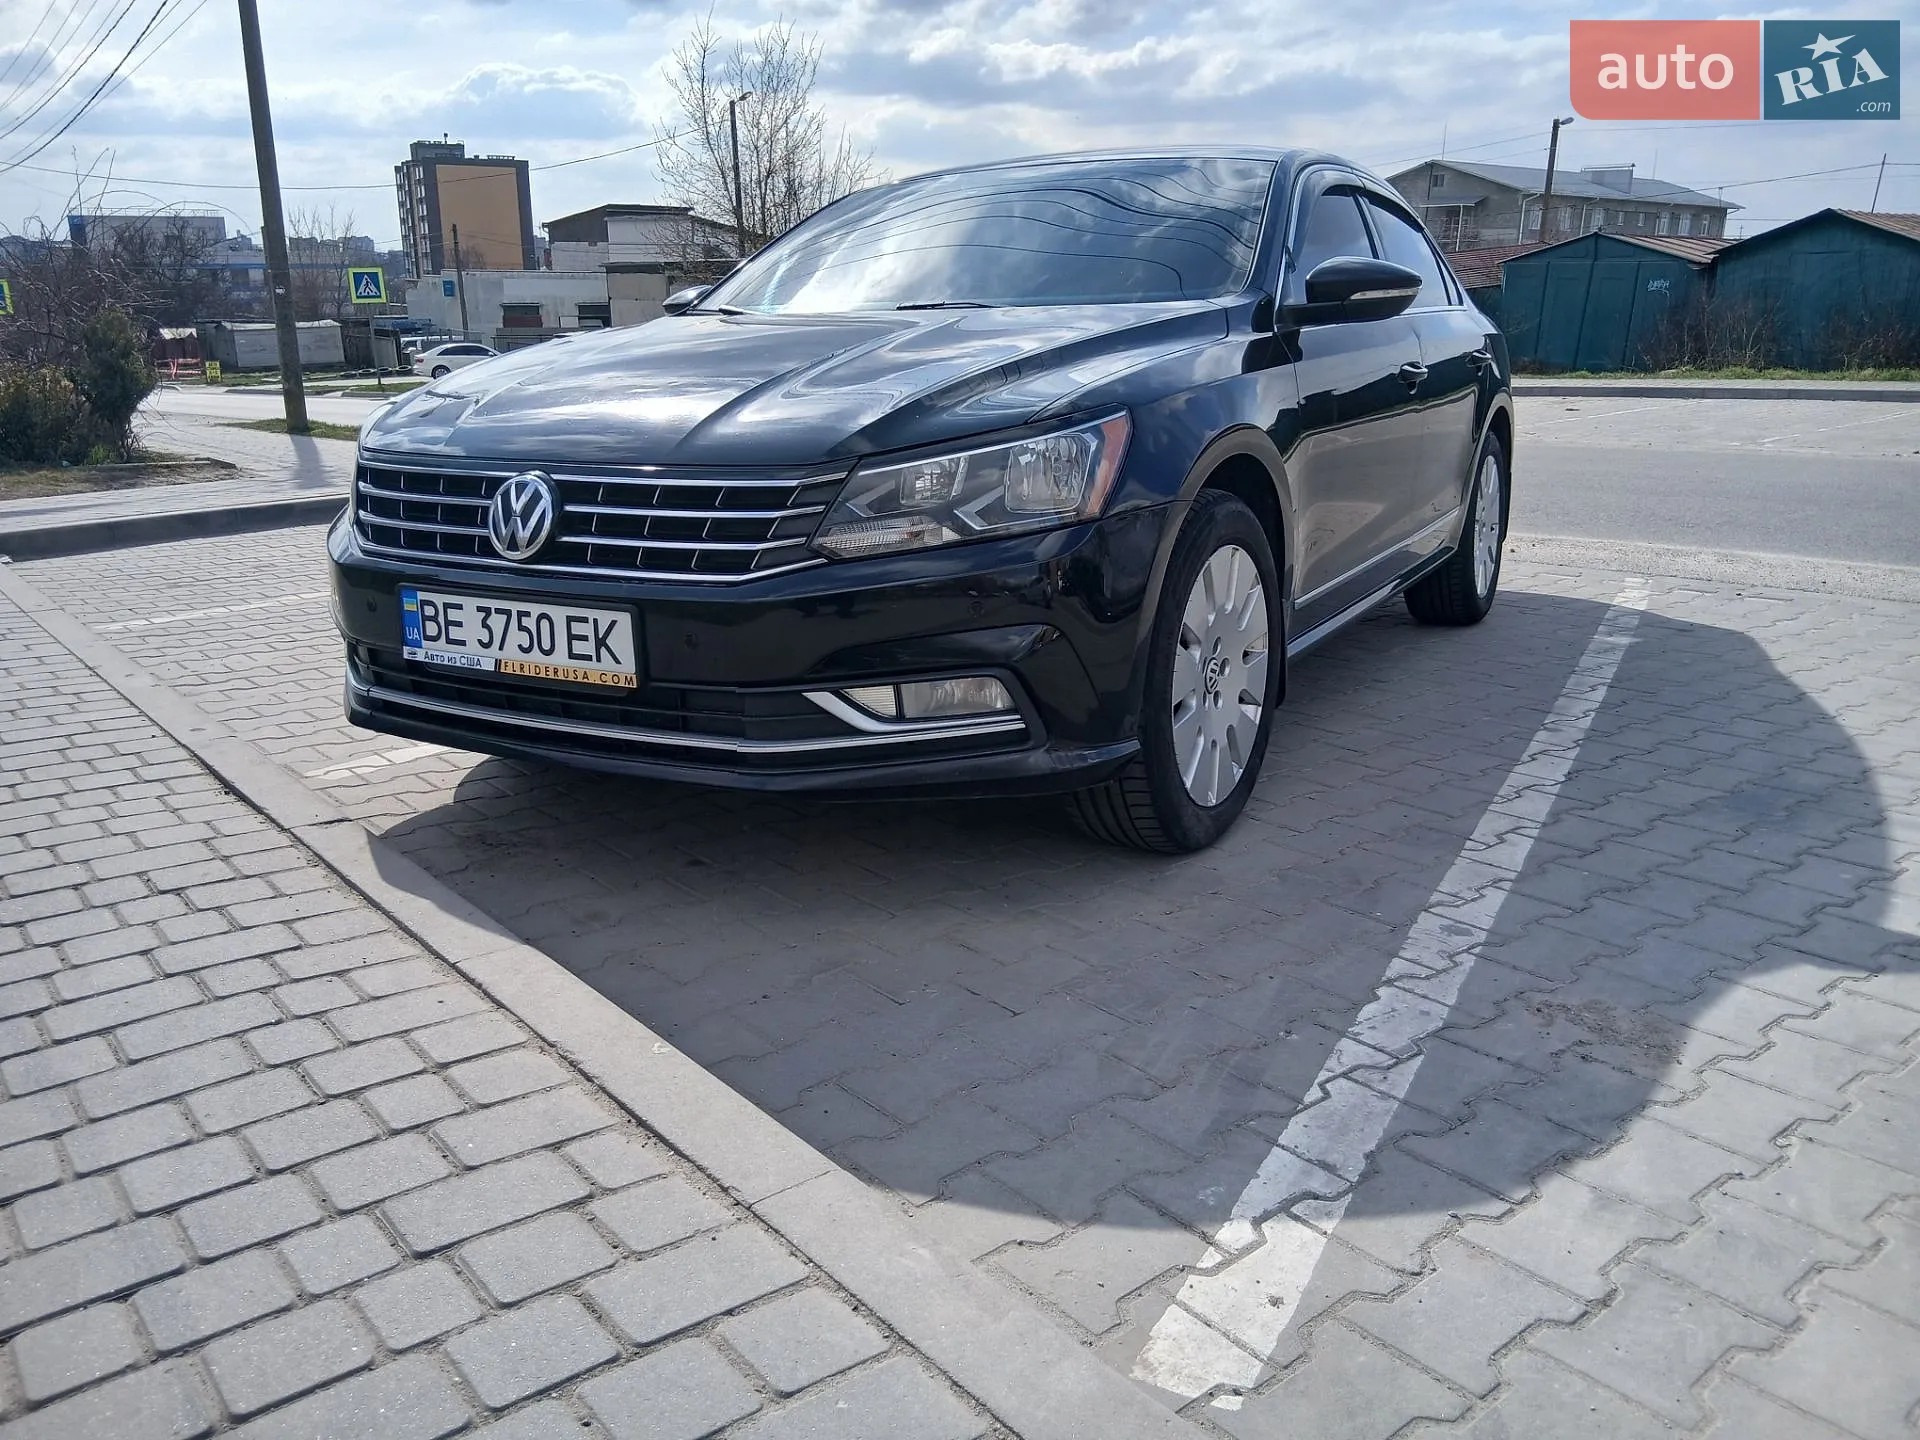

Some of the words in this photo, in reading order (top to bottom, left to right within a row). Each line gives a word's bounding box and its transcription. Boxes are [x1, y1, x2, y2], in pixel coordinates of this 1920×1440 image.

[405, 626, 420, 641] UA
[419, 599, 467, 647] BE
[476, 605, 556, 657] 3750
[566, 615, 622, 665] EK
[424, 651, 445, 663] Авто
[447, 656, 457, 665] из
[460, 655, 482, 668] США
[504, 661, 635, 687] FLRIDERUSA.COM
